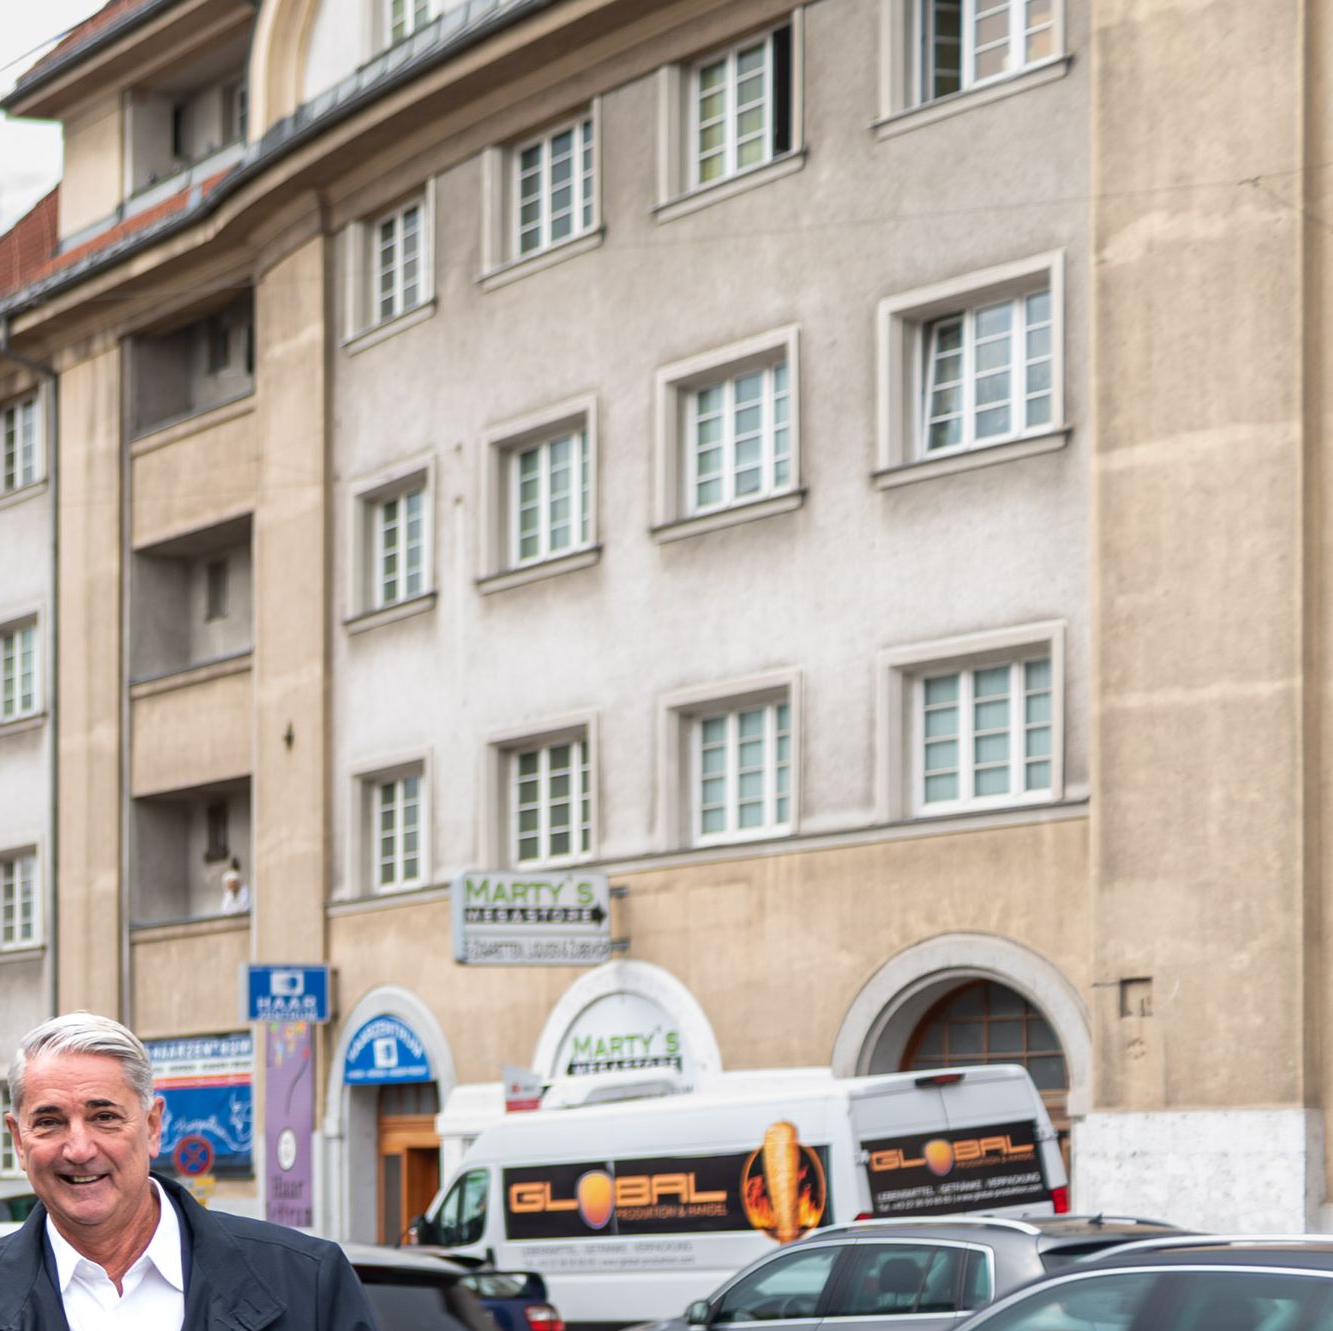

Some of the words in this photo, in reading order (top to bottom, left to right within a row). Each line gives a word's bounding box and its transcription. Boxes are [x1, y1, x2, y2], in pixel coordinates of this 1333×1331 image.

[466, 909, 592, 923] MEGASTORE
[257, 995, 317, 1010] HAAR
[347, 1021, 424, 1063] HAARZENTRUM
[871, 1135, 1035, 1176] GLOBAL
[509, 1170, 728, 1227] GLOBAL
